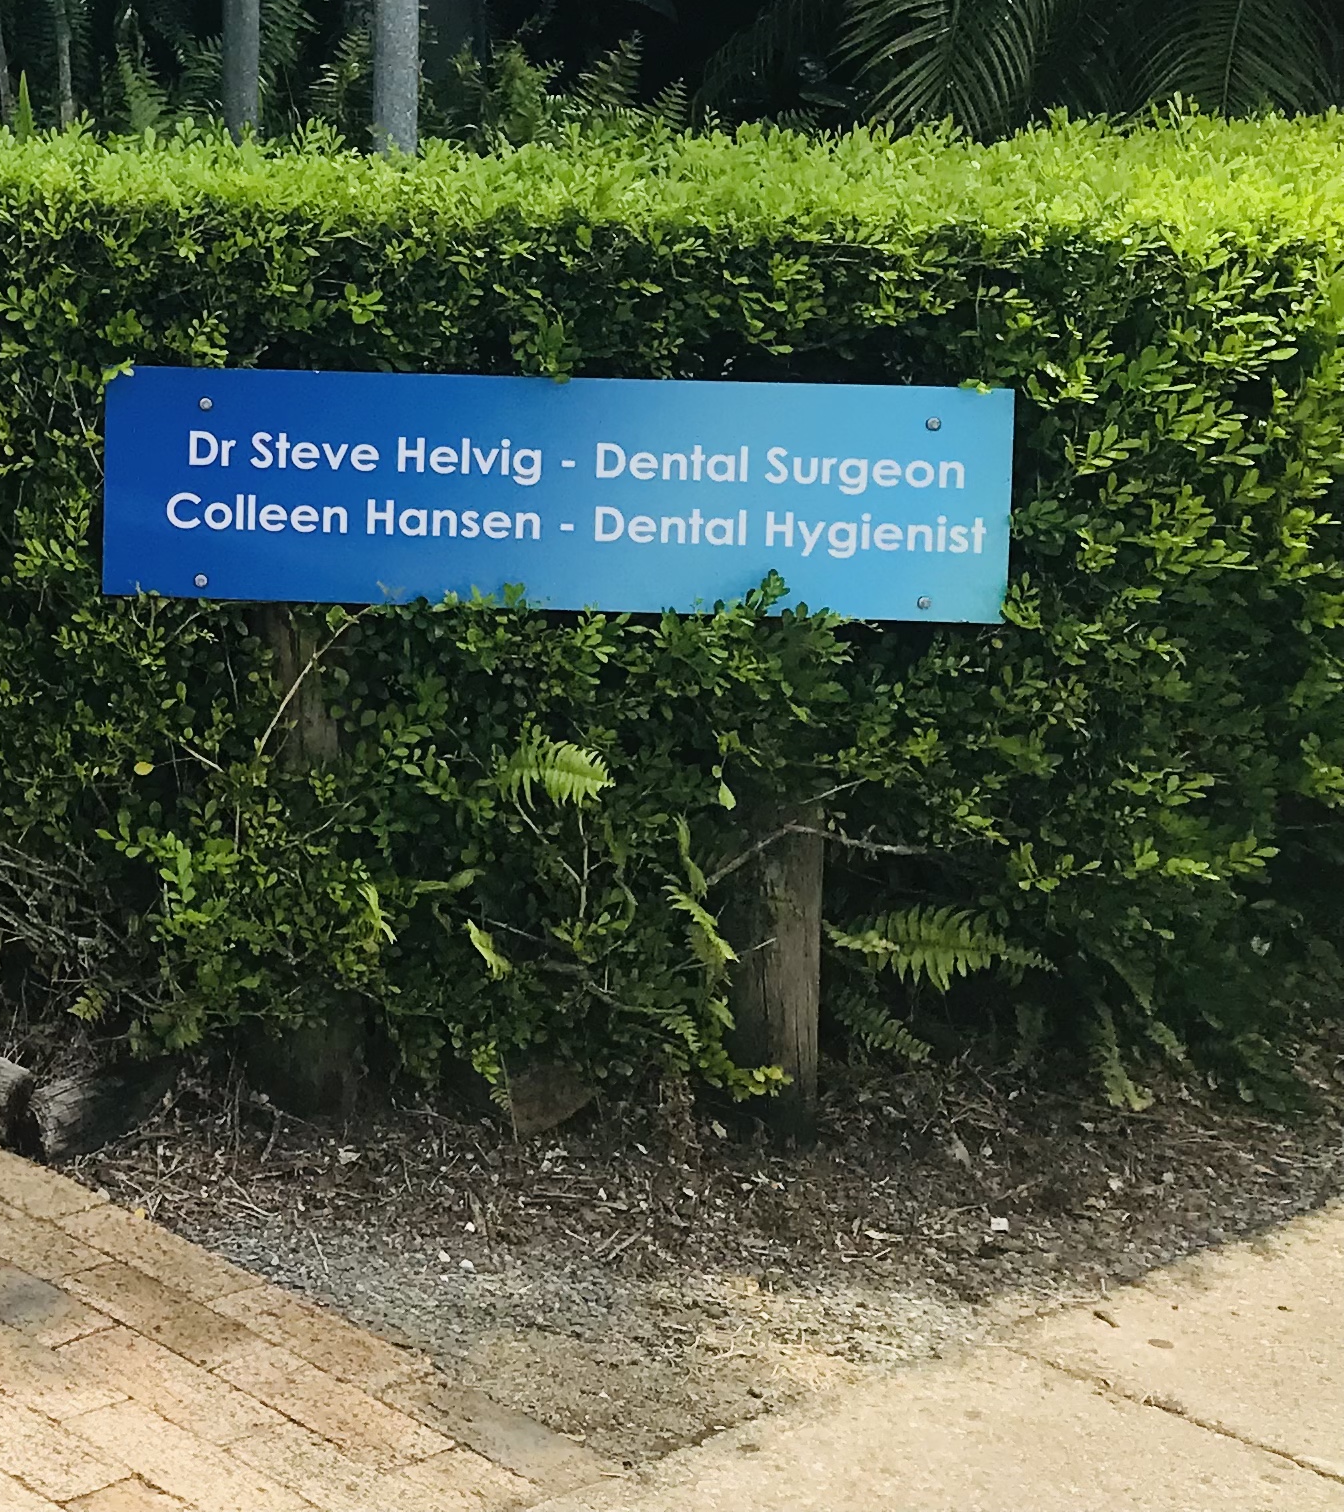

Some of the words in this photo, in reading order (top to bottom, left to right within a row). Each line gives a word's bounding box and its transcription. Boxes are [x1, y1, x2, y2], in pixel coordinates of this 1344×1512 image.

[188, 430, 236, 467] Dr
[249, 431, 379, 472] Steve
[397, 436, 542, 486] Helvig
[561, 458, 576, 469] -
[595, 442, 749, 484] Dental
[764, 446, 965, 495] Surgeon
[165, 492, 348, 534] Colleen
[366, 498, 541, 540] Hansen
[559, 522, 575, 532] -
[594, 505, 748, 547] Dental
[765, 511, 987, 558] Hygienist
